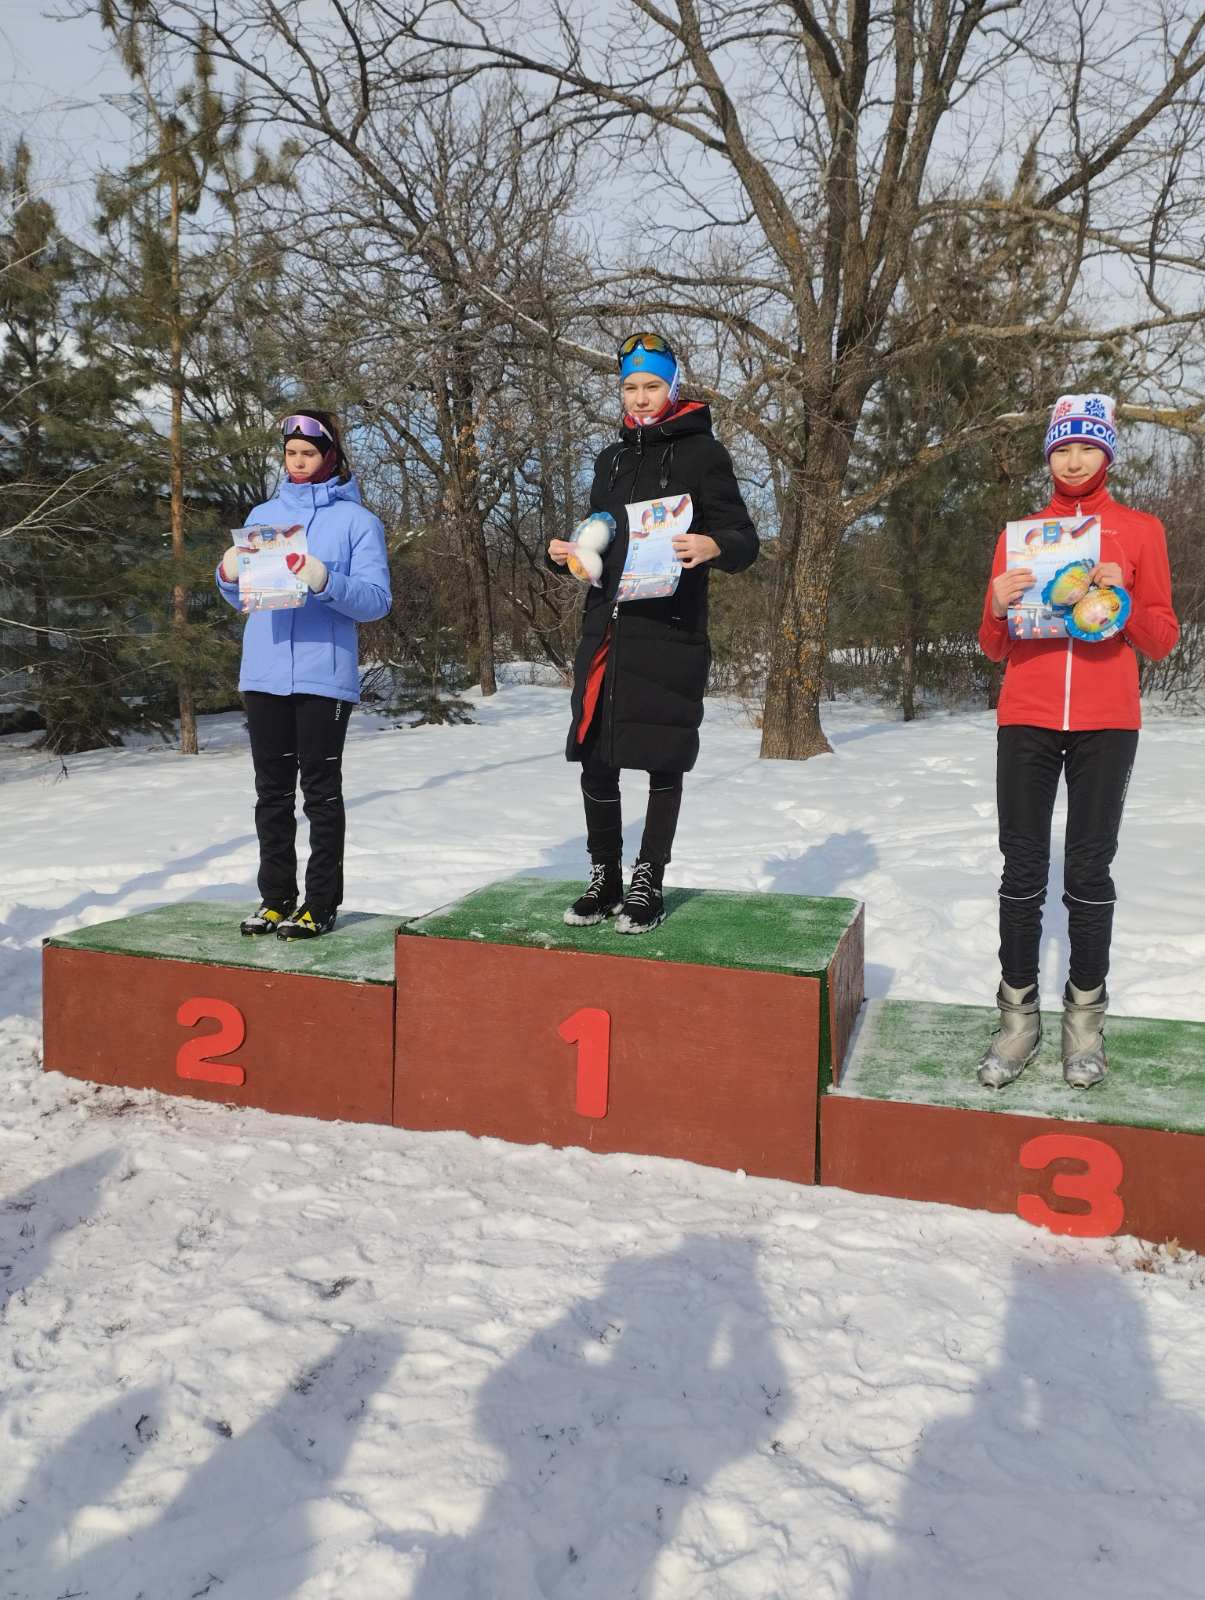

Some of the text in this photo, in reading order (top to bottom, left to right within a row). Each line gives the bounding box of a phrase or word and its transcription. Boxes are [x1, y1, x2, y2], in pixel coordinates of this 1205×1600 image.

[176, 997, 246, 1087] 2
[558, 1008, 611, 1119] 1
[1017, 1134, 1124, 1237] 3
